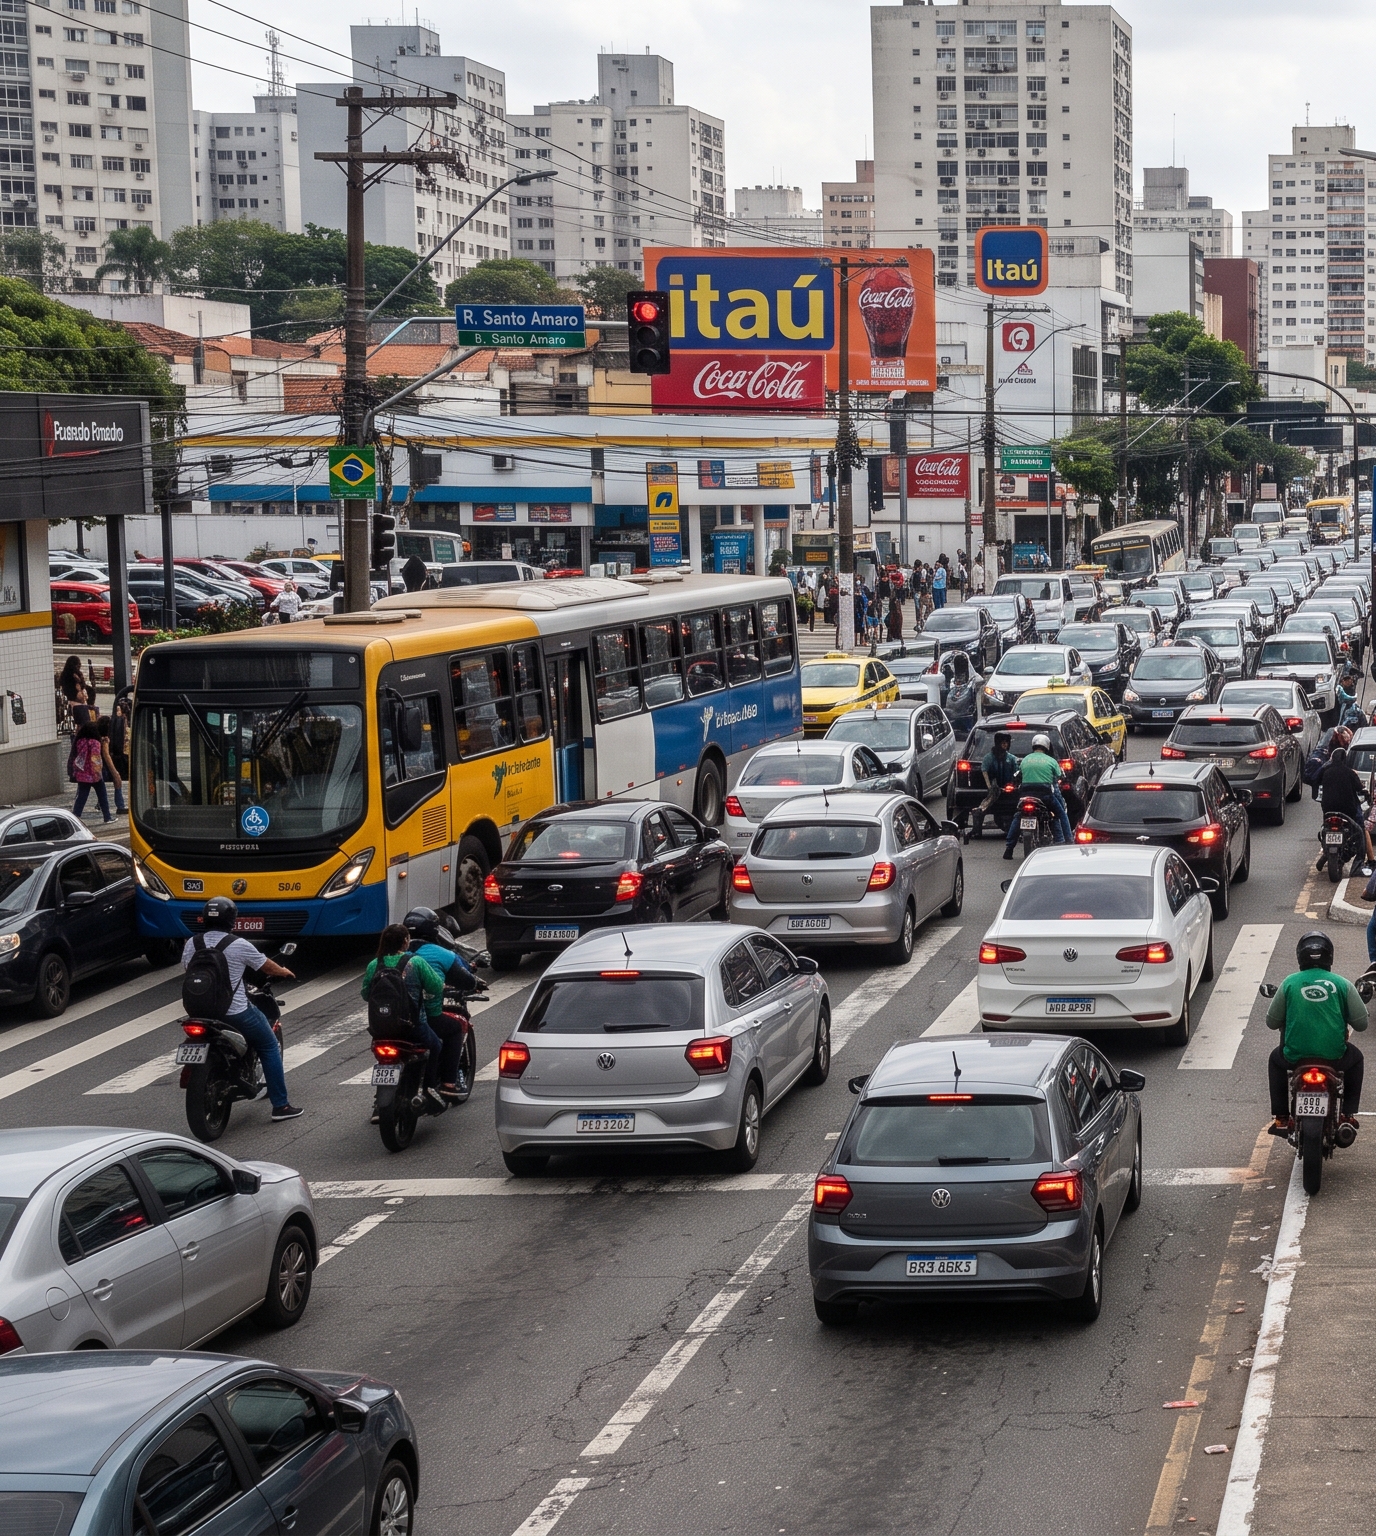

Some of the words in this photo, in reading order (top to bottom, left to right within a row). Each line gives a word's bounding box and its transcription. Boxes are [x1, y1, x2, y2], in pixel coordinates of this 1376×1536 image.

[987, 258, 1038, 281] Itaú
[669, 274, 824, 340] itaú
[463, 309, 477, 325] R.
[483, 309, 526, 326] Santo
[531, 311, 578, 326] Amaro
[475, 333, 486, 344] B.
[492, 333, 524, 344] Santo
[530, 334, 566, 345] Amaro
